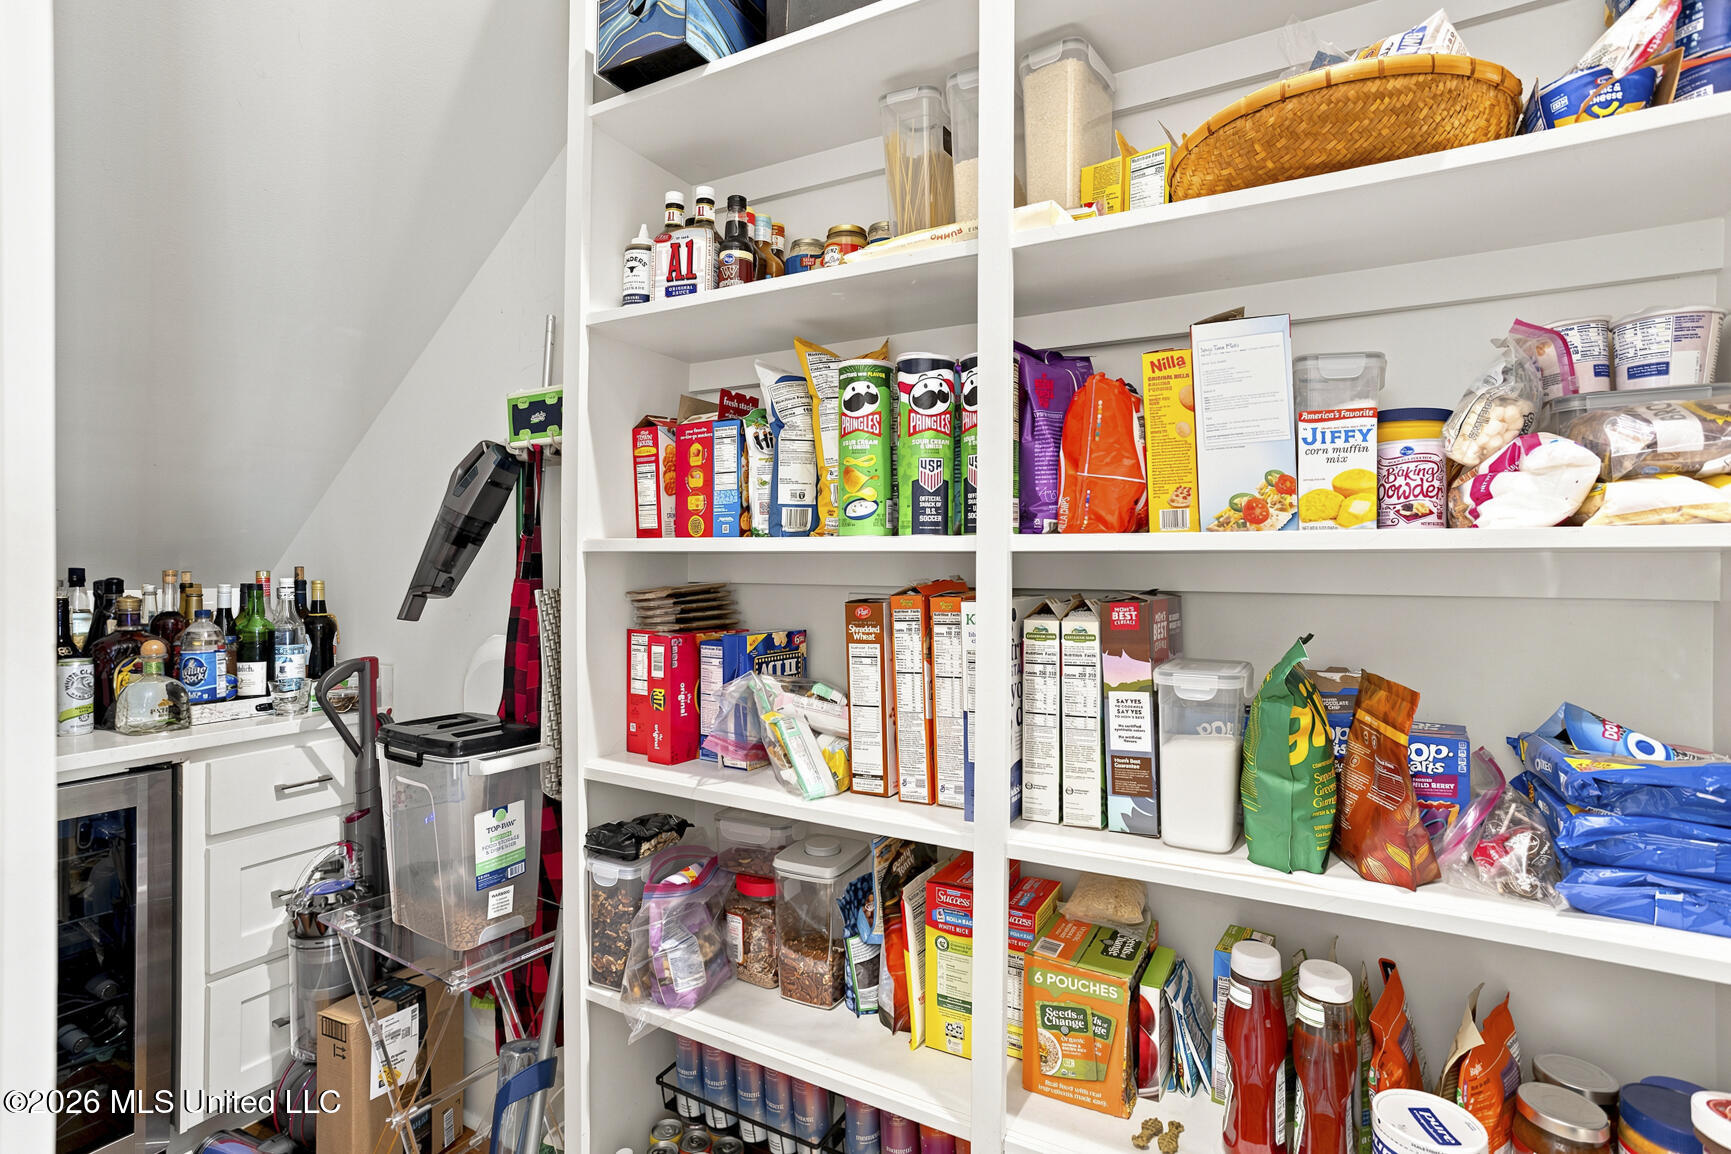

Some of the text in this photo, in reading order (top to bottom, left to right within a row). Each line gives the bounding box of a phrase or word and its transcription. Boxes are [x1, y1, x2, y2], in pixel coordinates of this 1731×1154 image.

[1150, 355, 1186, 374] Nilla
[723, 396, 738, 408] fresh
[1301, 408, 1374, 420] America's Favorite
[841, 412, 880, 434] PRINGLES
[910, 412, 951, 434] PRINGLES
[1304, 444, 1370, 456] corn muffin
[920, 460, 942, 472] USA
[1326, 454, 1348, 464] mix
[1384, 463, 1435, 484] Baking
[1112, 612, 1137, 620] BEST
[848, 625, 880, 634] Shredded
[852, 632, 876, 640] Wheat
[1154, 621, 1167, 640] BEST
[760, 660, 782, 676] ACT
[653, 688, 665, 712] RITZ
[678, 682, 688, 717] original
[937, 890, 970, 907] Success
[938, 923, 969, 936] WHITE RICE
[1034, 972, 1118, 999] 6 POUCHES
[1046, 1007, 1077, 1019] Seeds
[1044, 1015, 1085, 1029] Change
[1039, 1084, 1073, 1098] ingredients
[1074, 1094, 1091, 1103] made
[1059, 1082, 1073, 1091] food
[1075, 1086, 1088, 1095] with
